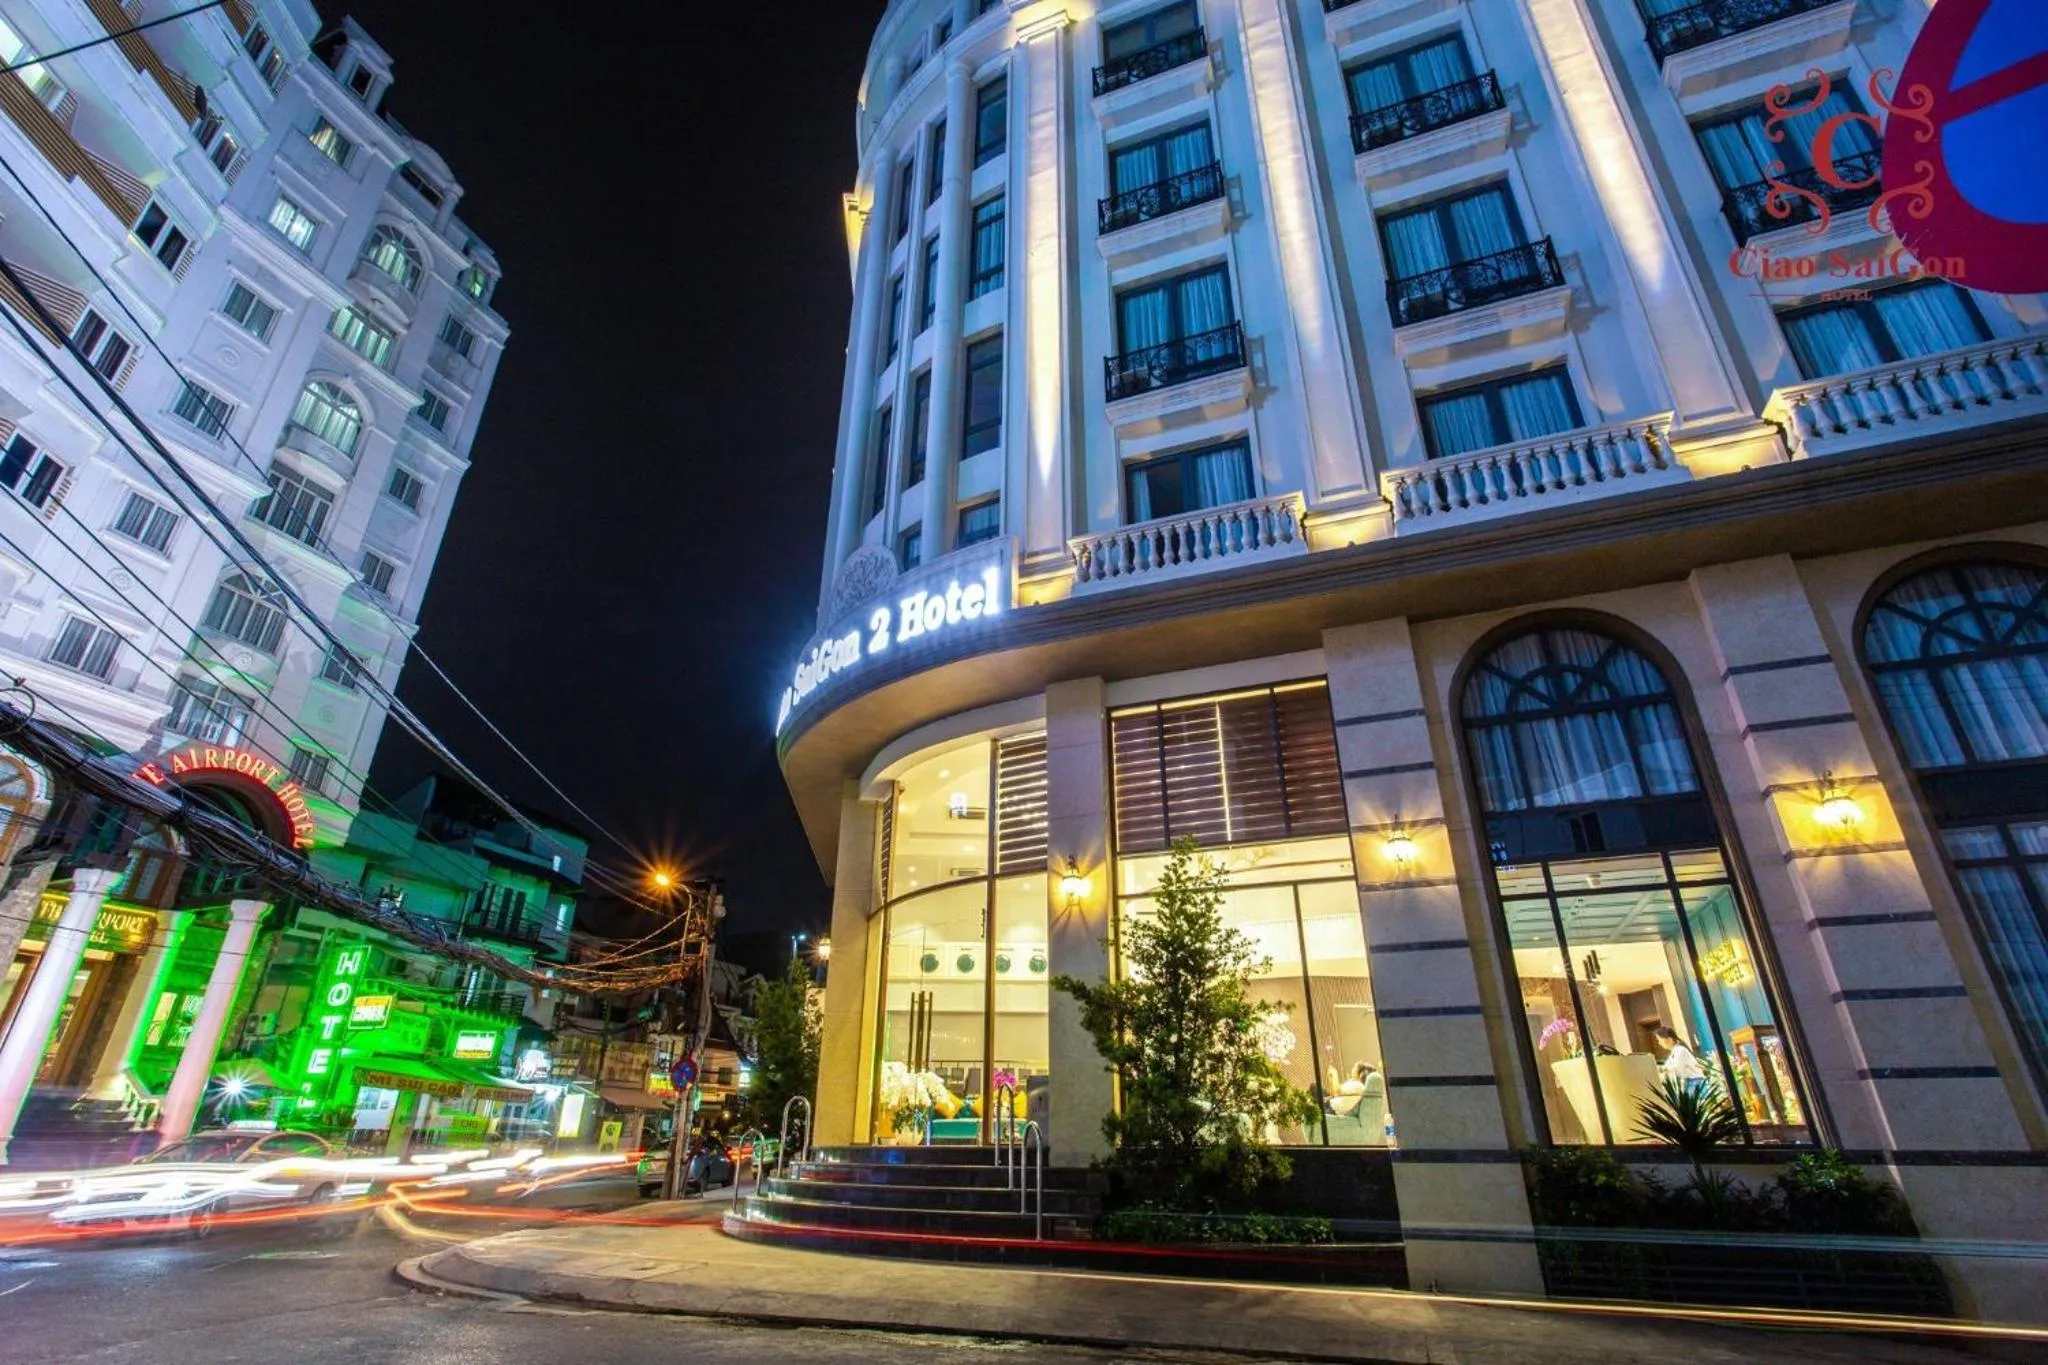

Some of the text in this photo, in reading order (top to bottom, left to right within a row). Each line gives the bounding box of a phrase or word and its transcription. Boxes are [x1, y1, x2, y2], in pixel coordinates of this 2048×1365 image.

[869, 607, 891, 653] 2
[897, 566, 1001, 642] Hotel
[172, 747, 280, 786] AIRPORT
[276, 781, 314, 849] HOTEL
[297, 951, 361, 1108] HOTEL
